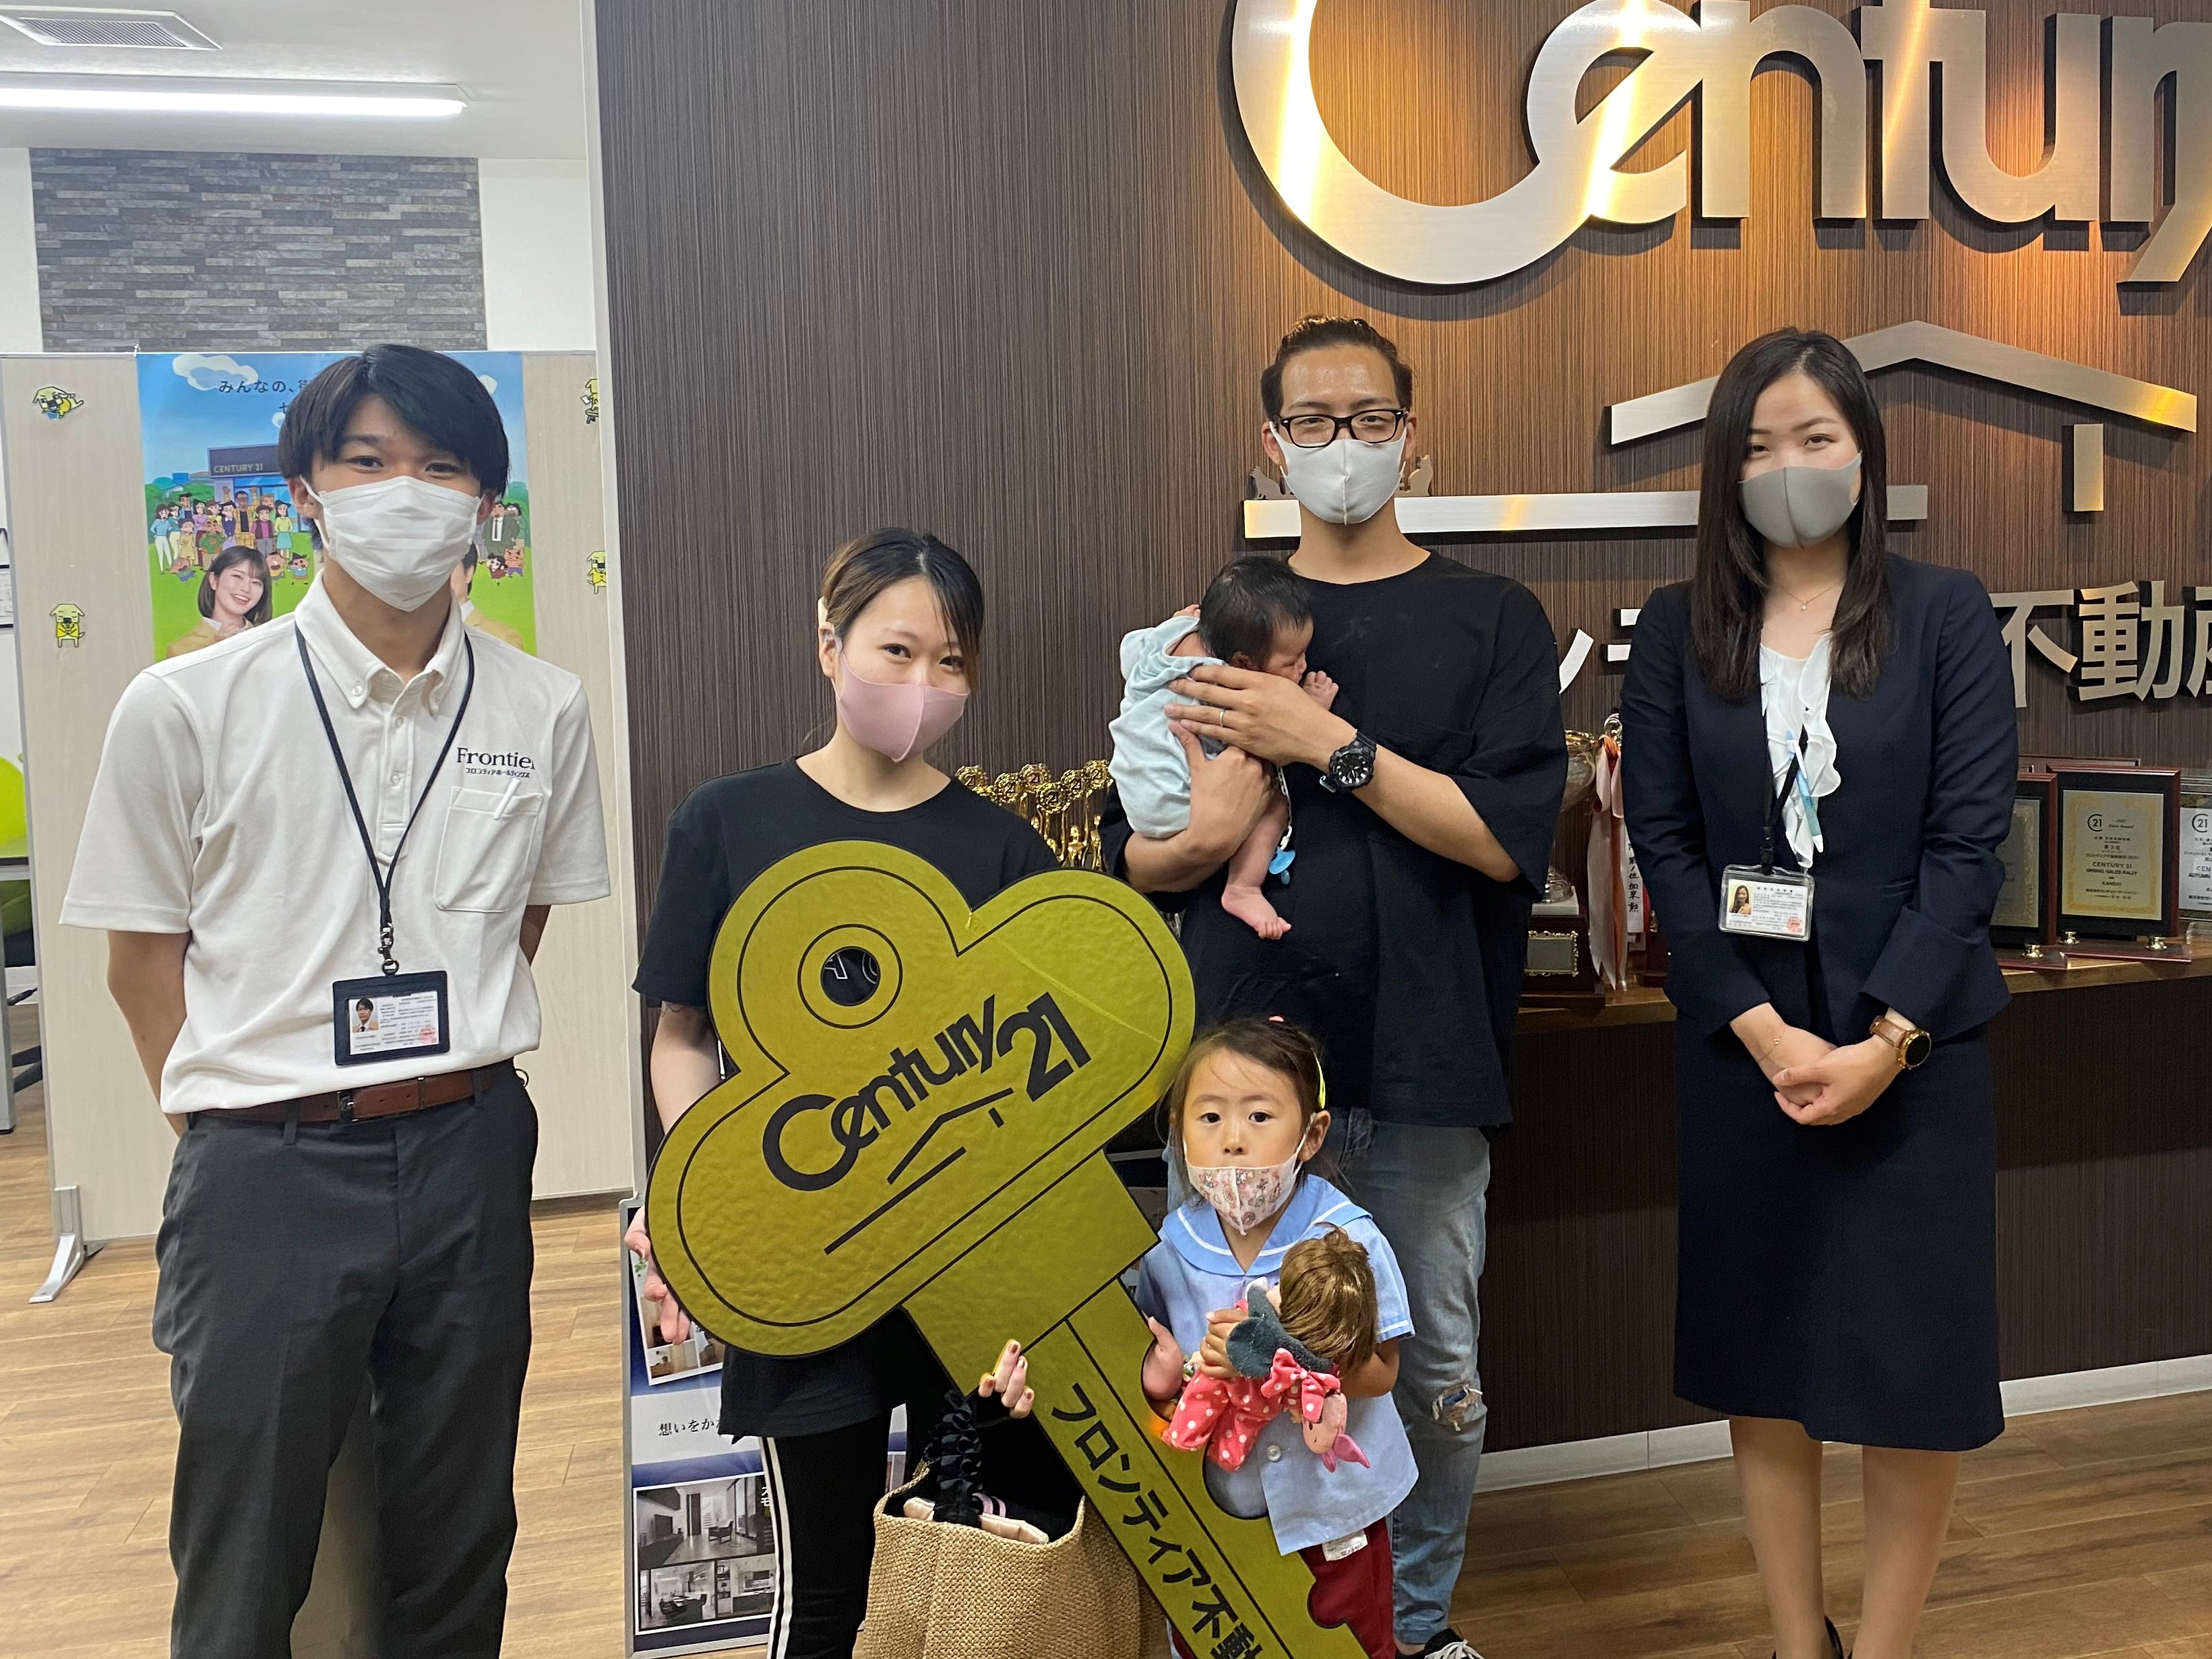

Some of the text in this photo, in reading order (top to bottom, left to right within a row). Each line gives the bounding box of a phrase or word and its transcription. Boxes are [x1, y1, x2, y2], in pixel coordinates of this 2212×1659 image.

[214, 463, 263, 473] CENTURY 21
[762, 991, 1092, 1191] Century 21
[658, 1418, 720, 1437] 想いをか
